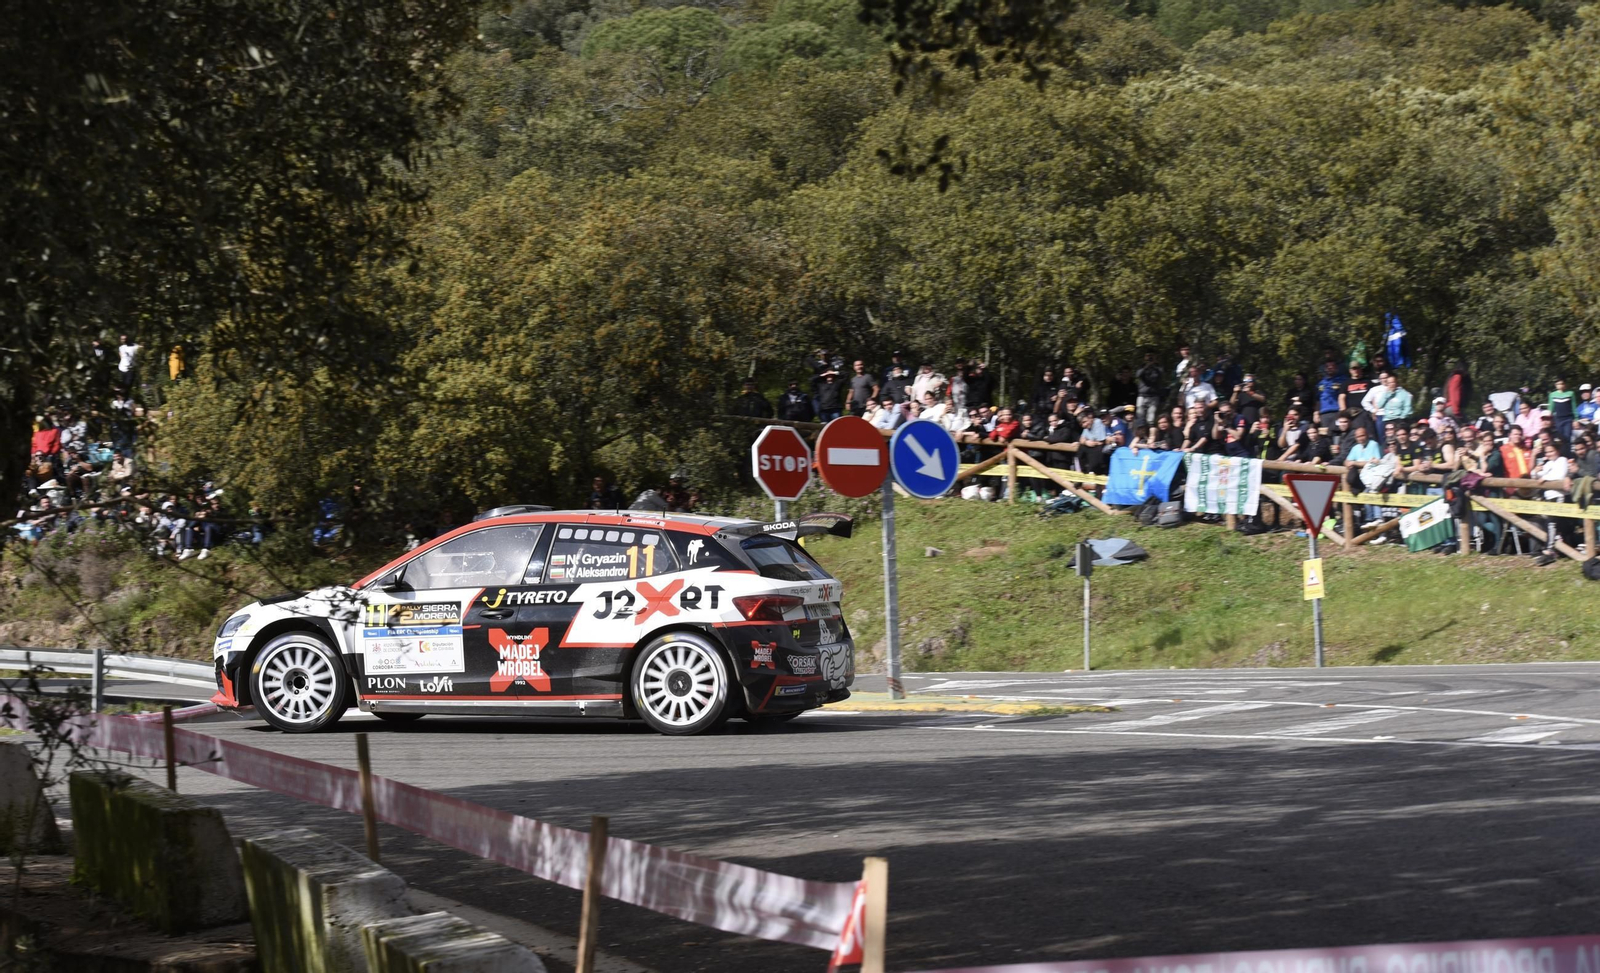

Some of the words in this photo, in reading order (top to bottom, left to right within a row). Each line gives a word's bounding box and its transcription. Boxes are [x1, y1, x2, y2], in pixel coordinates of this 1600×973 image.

[759, 454, 807, 472] STOP
[762, 521, 796, 532] SKODA
[566, 554, 578, 565] N.
[581, 552, 626, 567] Gryazin
[626, 545, 655, 578] 11
[566, 568, 575, 578] K.
[576, 567, 628, 578] Aleksandrov
[506, 590, 567, 605] TYRETO
[367, 604, 385, 627] 11
[422, 604, 458, 612] SIERRA
[414, 612, 458, 620] MORENA
[499, 644, 540, 660] MADEJ
[367, 677, 406, 689] PLON
